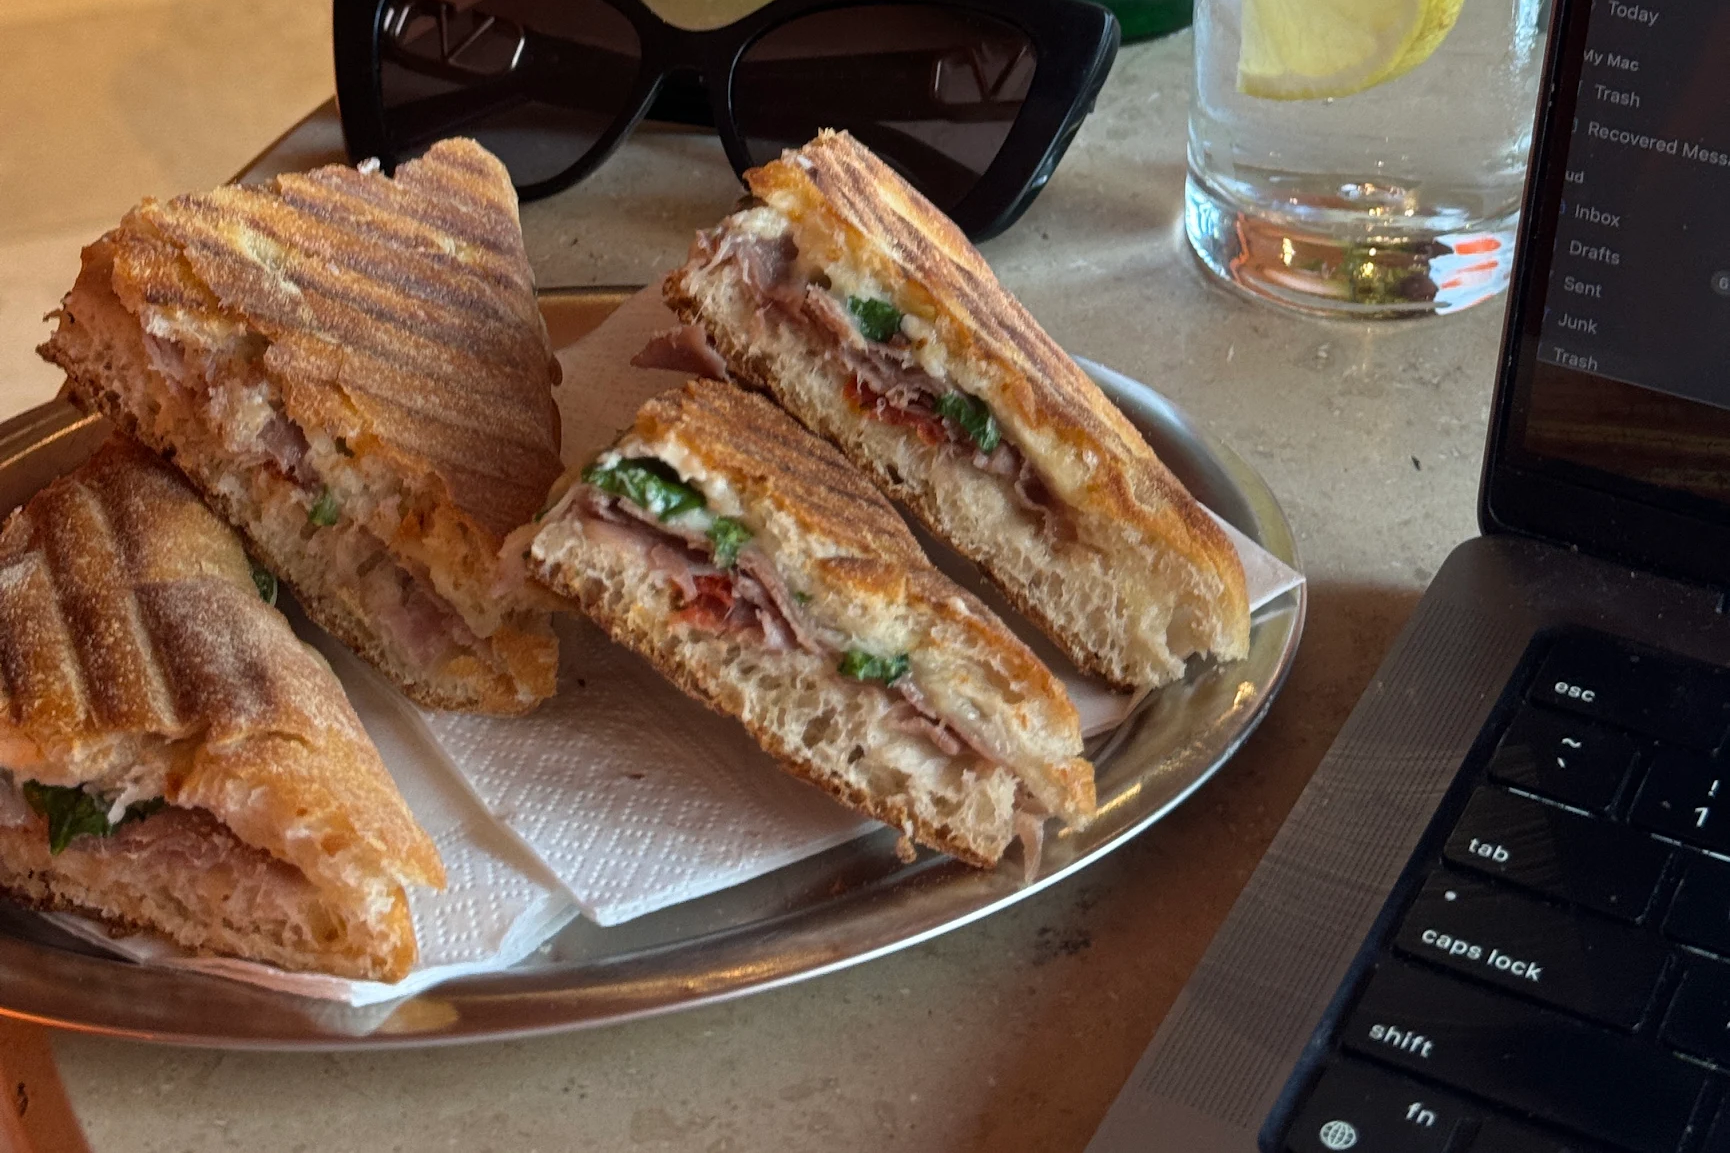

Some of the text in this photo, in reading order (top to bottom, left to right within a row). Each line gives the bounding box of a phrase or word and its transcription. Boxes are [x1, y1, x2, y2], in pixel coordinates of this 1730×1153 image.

[1608, 0, 1660, 27] Today
[1607, 52, 1640, 72] Mac
[1594, 83, 1641, 108] Trash
[1587, 120, 1730, 167] Recovered Mess
[1574, 204, 1621, 228] Inbox
[1569, 240, 1621, 265] Drafts
[1563, 275, 1602, 297] Sent
[1558, 313, 1598, 335] Junk
[1553, 347, 1598, 371] Trash
[1554, 681, 1596, 703] esc
[1694, 806, 1710, 828] 1
[1468, 837, 1510, 863] tab
[1421, 928, 1545, 983] caps lock
[1368, 1021, 1435, 1059] shift
[1405, 1100, 1438, 1128] fn
